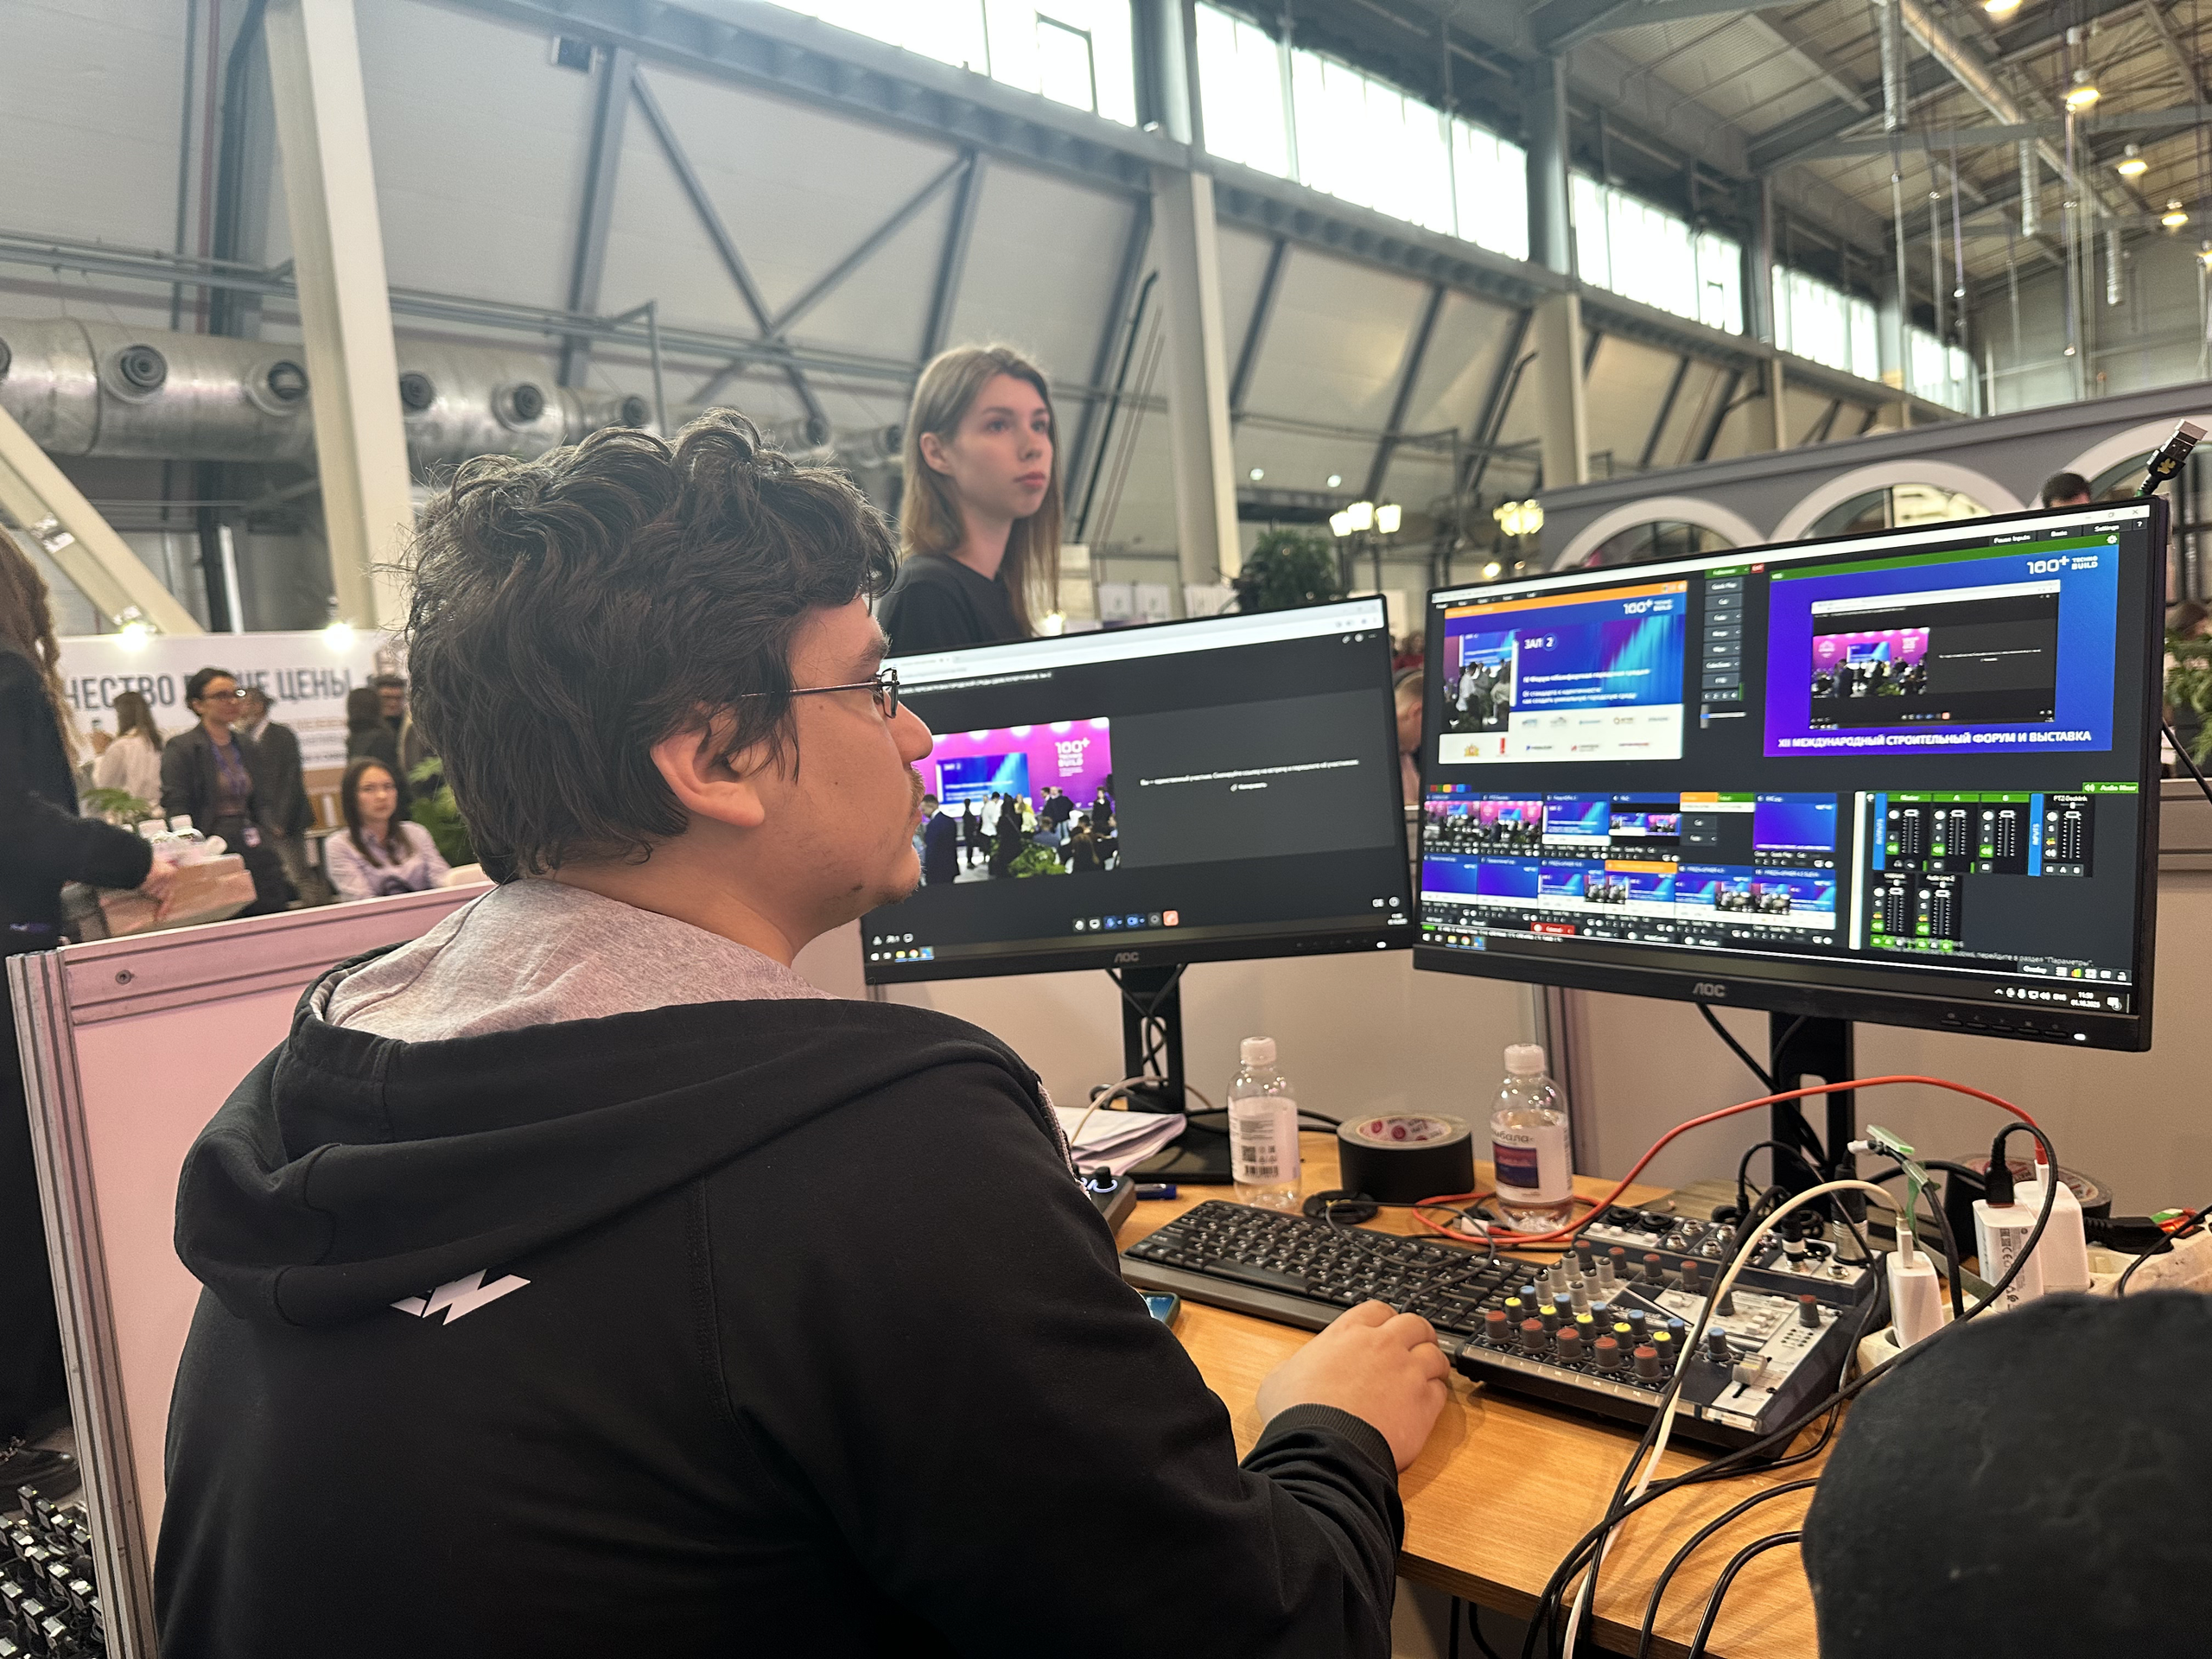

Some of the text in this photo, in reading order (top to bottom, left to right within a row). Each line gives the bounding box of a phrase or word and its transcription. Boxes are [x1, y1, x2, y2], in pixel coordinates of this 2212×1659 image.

[2071, 562, 2098, 570] BUILD
[1545, 636, 1555, 648] 2
[276, 668, 350, 703] ЦЕНЫ
[1792, 734, 1885, 748] МЕЖДУНАРОДНЫЙ
[1886, 732, 1971, 746] СТРОИТЕЛЬНЫЙ
[1973, 732, 2016, 744] ФОРУМ
[2018, 732, 2027, 743] И
[2029, 731, 2092, 742] ВЫСТАВКА
[1115, 951, 1140, 963] AOC
[1693, 982, 1726, 998] AOC
